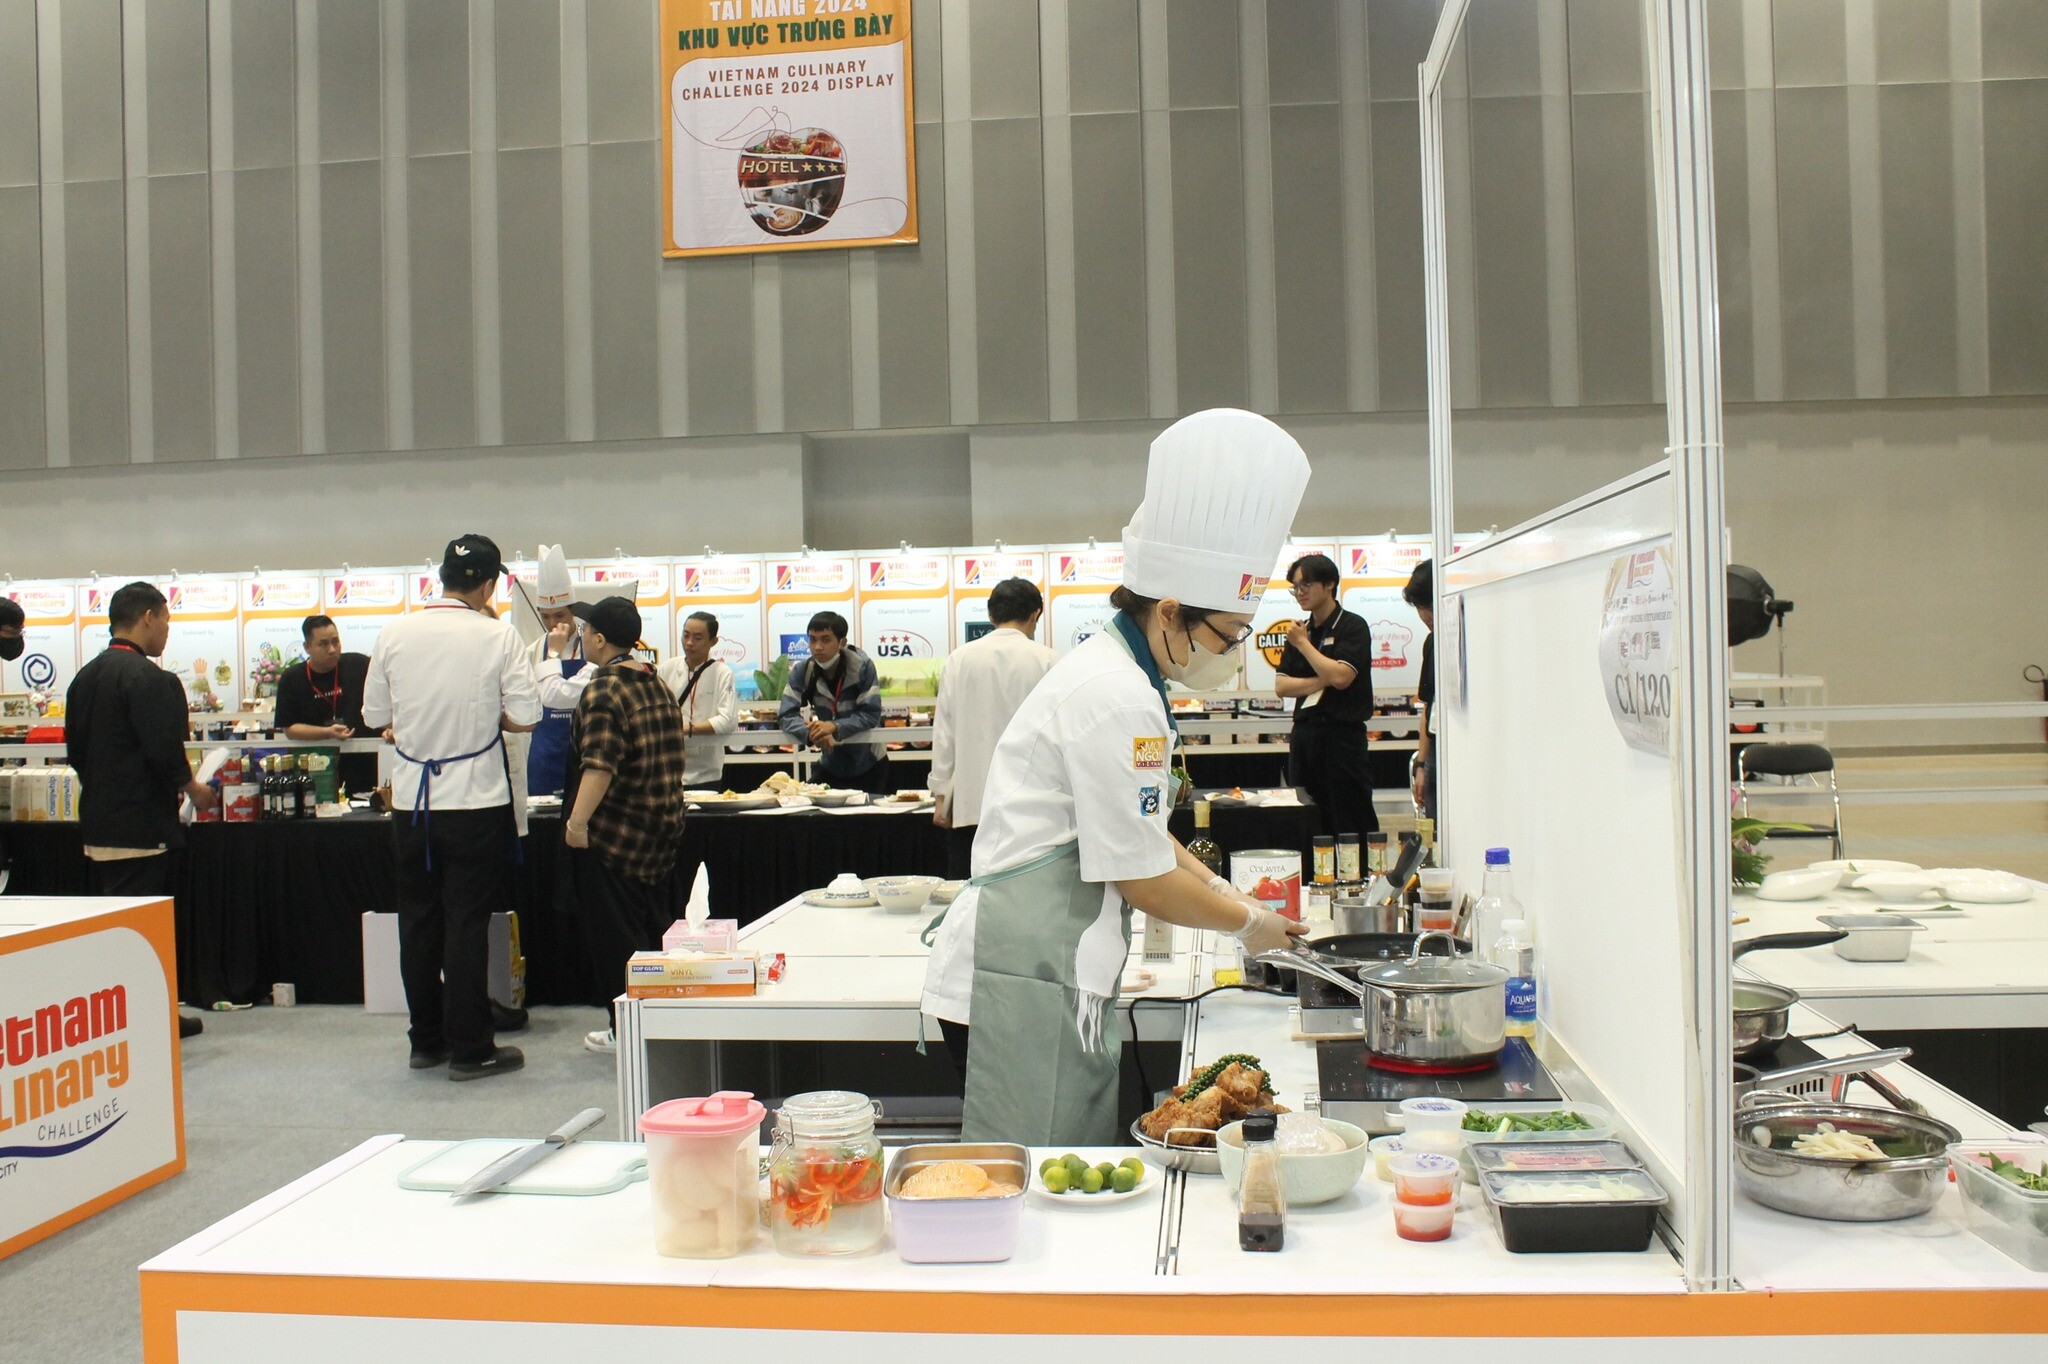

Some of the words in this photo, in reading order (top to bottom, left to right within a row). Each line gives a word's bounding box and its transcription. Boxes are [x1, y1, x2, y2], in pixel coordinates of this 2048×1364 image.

[678, 28, 719, 50] KHU
[727, 22, 769, 50] VỰC
[777, 18, 846, 43] TRƯNG
[854, 12, 894, 38] BÀY
[708, 66, 780, 83] VIETNAM
[787, 59, 867, 78] CULINARY
[682, 82, 775, 101] CHALLENGE
[781, 81, 820, 95] 2024
[828, 73, 895, 92] DISPLAY
[740, 160, 800, 175] HOTEL
[877, 645, 913, 657] USA
[1258, 633, 1288, 648] CALIF
[1615, 671, 1671, 723] C1/120
[1249, 865, 1287, 874] COLAVITA
[0, 984, 128, 1071] tnam
[37, 1097, 120, 1142] CHALLENGE
